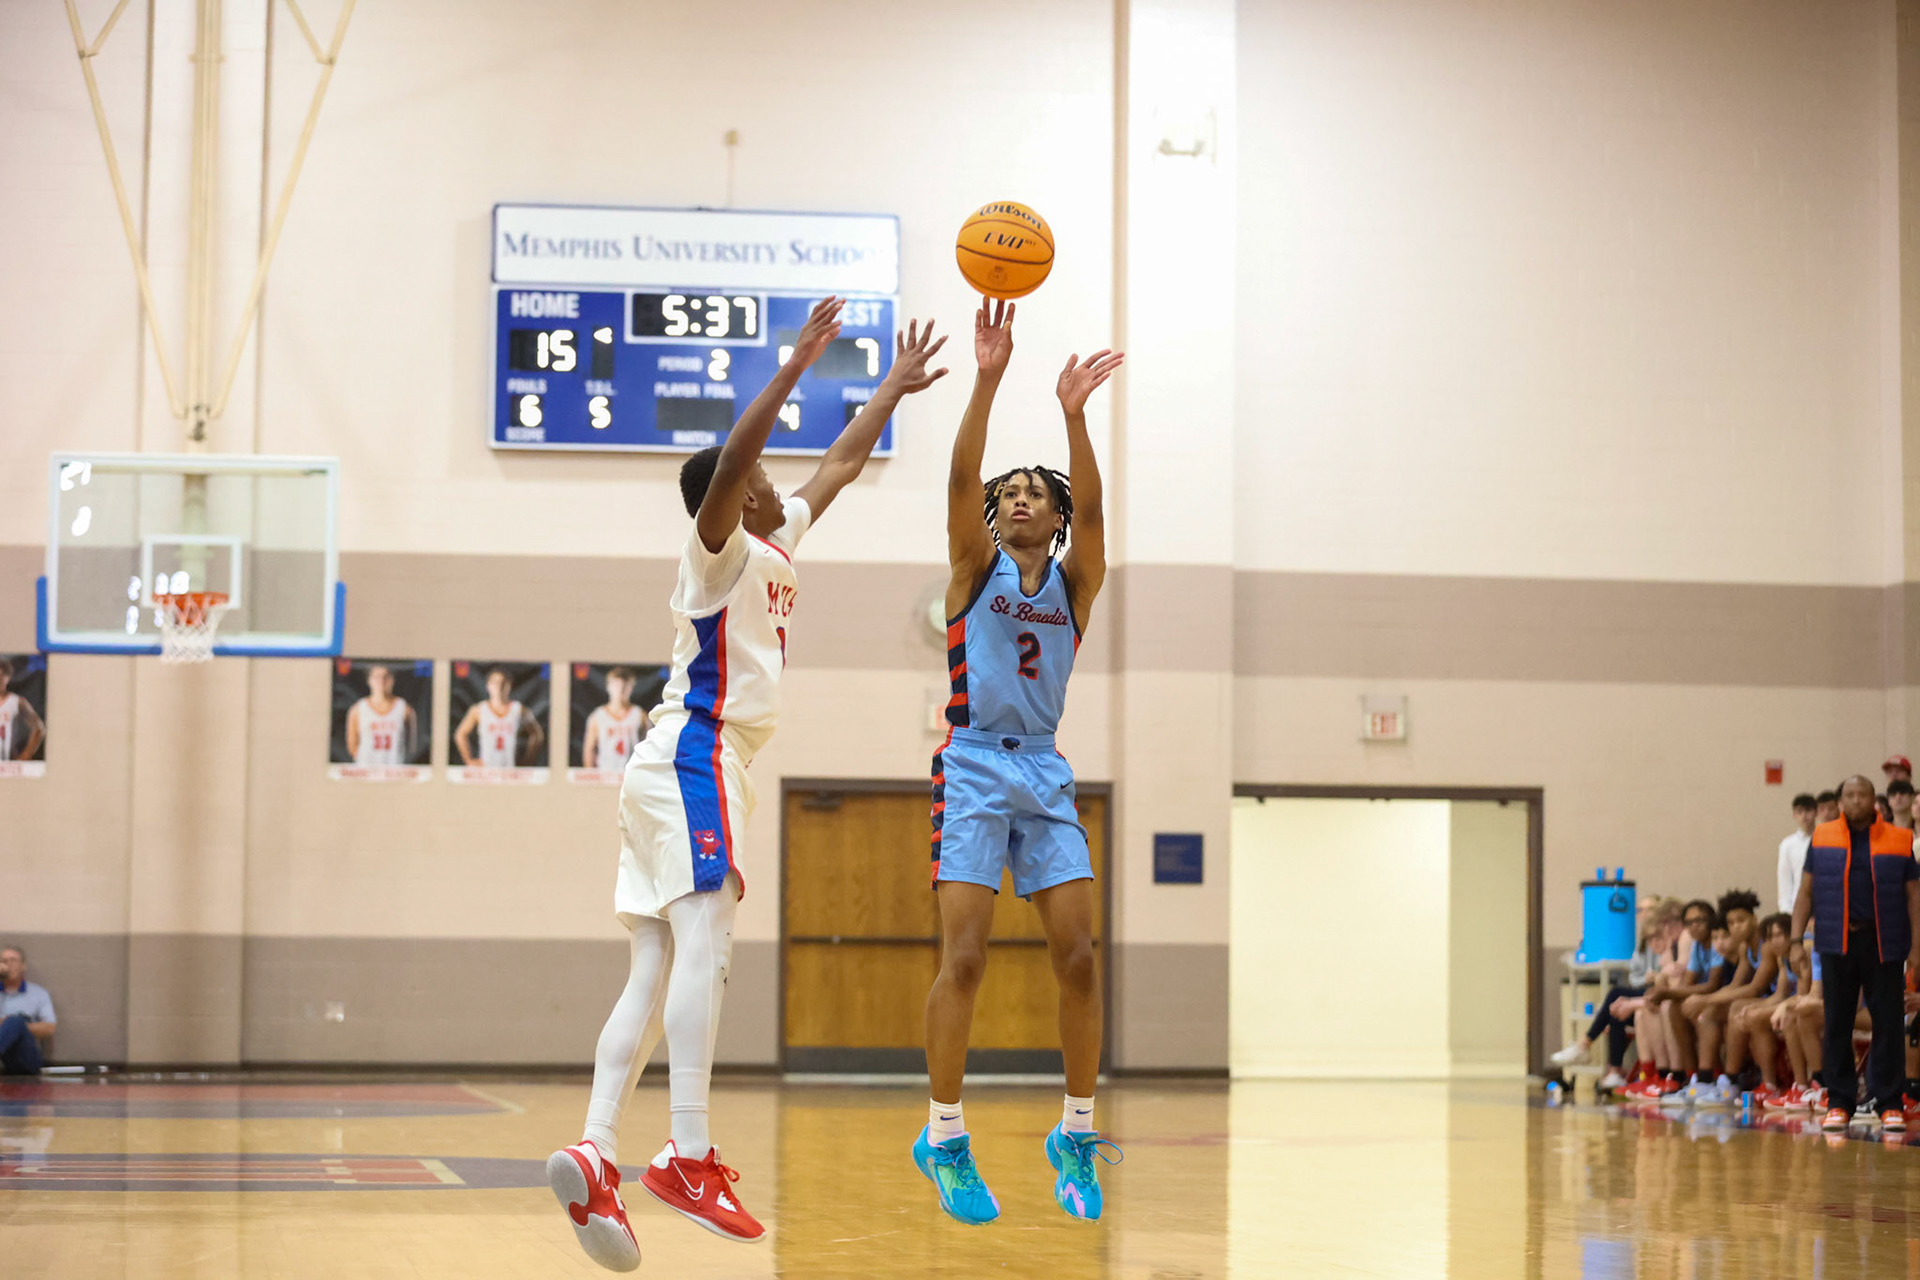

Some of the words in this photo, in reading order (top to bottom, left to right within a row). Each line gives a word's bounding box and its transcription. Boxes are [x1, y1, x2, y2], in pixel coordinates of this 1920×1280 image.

[979, 205, 1042, 230] Wilson
[503, 232, 623, 260] MEMPHIS
[633, 233, 779, 265] UNIVERSITY
[788, 239, 880, 267] SCHO
[510, 292, 580, 319] HOME
[662, 294, 757, 338] 5:37
[537, 329, 577, 372] 15
[707, 348, 731, 381] 2
[855, 338, 879, 377] 7
[519, 394, 543, 428] 6
[588, 396, 612, 429] 5
[1016, 631, 1042, 681] 2
